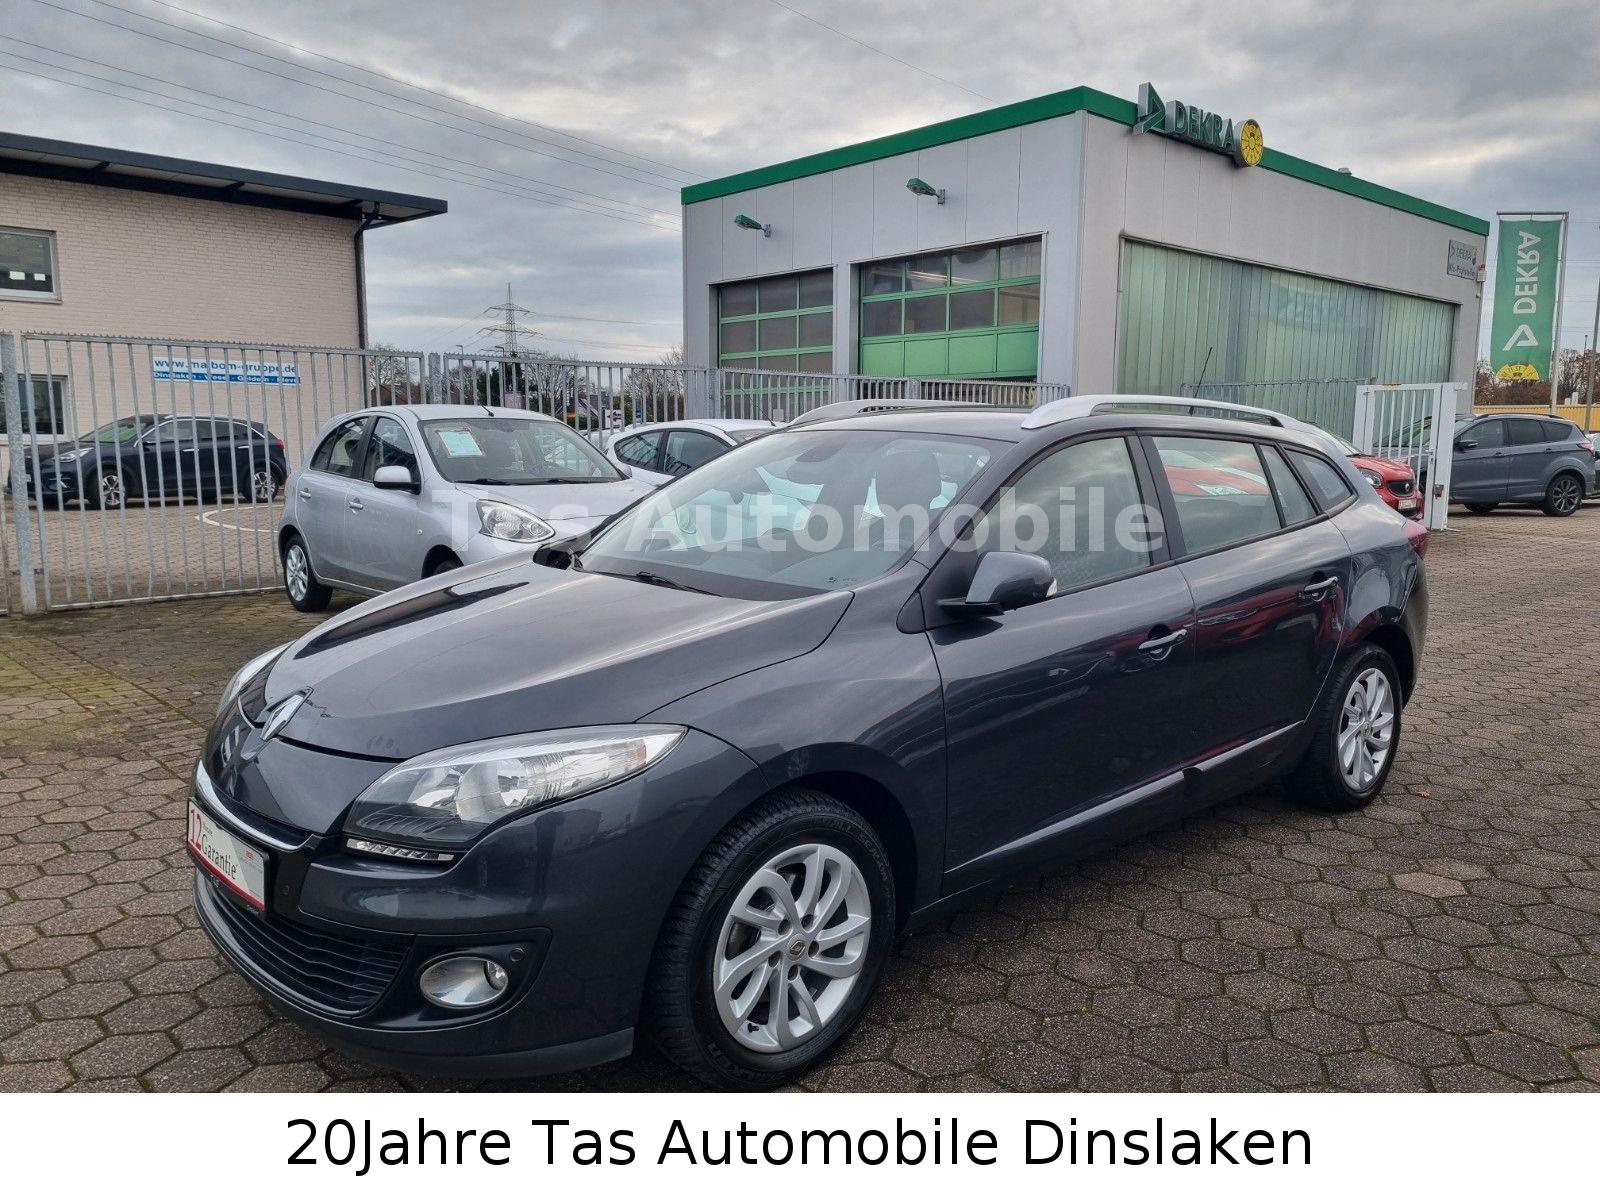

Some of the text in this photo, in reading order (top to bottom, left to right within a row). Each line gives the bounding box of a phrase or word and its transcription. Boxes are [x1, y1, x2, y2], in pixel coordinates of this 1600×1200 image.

[1169, 100, 1235, 152] DEKRA
[154, 359, 297, 374] www.mabom-gruppe.de
[189, 808, 238, 881] 12 Garantie
